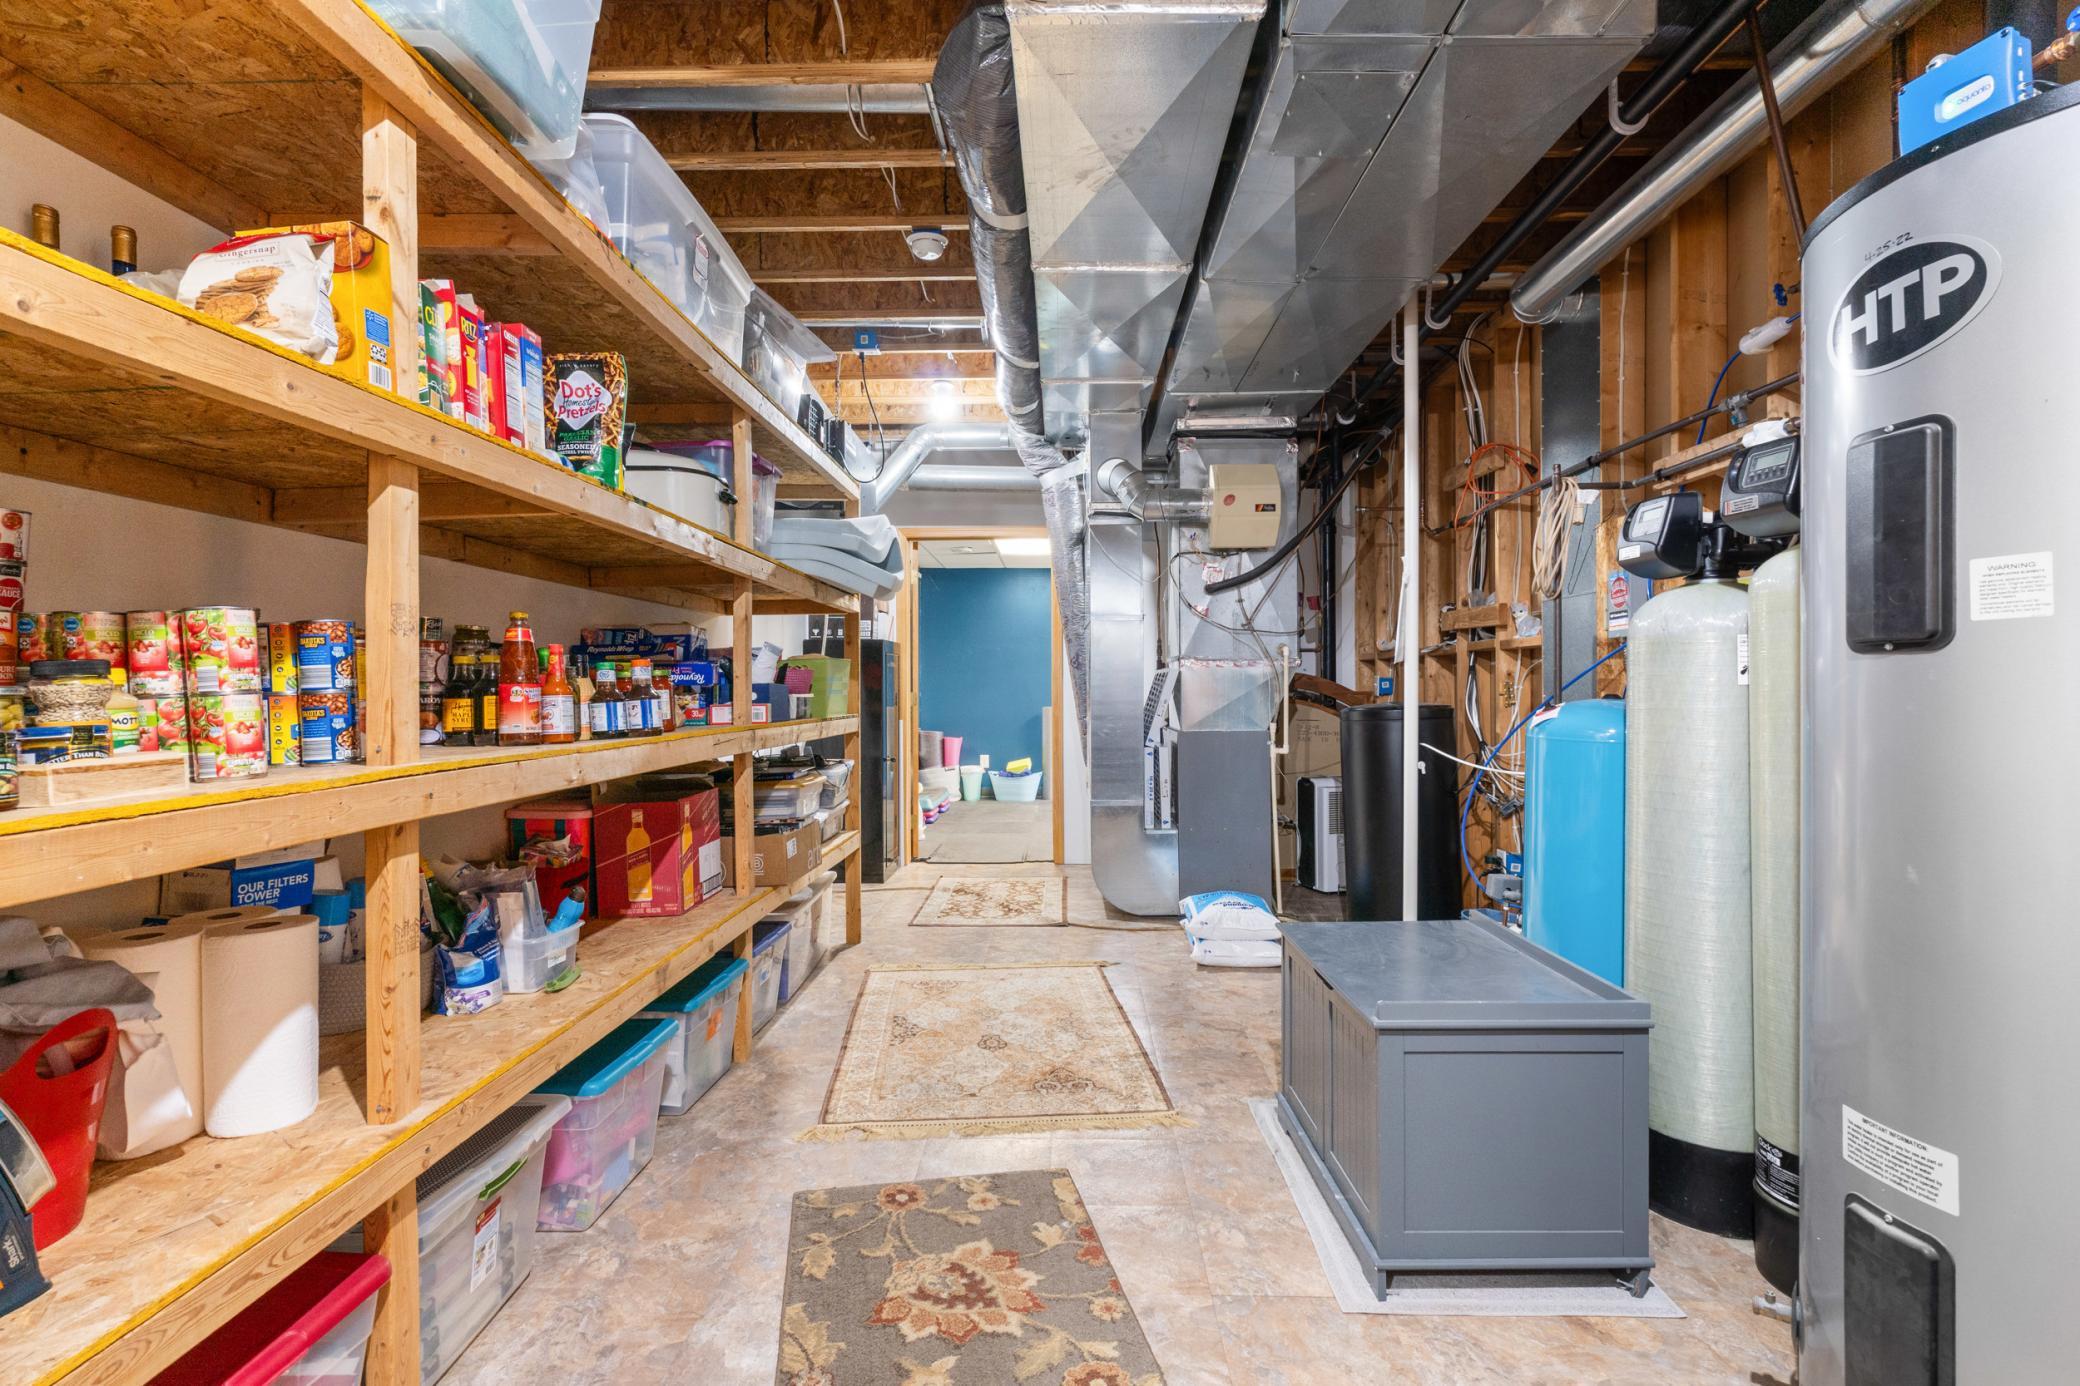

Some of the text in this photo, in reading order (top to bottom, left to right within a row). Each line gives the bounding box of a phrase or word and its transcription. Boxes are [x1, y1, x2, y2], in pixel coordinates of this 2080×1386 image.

[1840, 253, 1976, 356] HTP
[461, 315, 477, 338] RITZ
[560, 381, 602, 399] Dot's
[558, 400, 606, 420] Pretzels
[1986, 560, 2036, 573] WARNING
[238, 873, 309, 894] OUR FILTERS
[237, 888, 280, 904] TOWER
[1889, 1130, 1927, 1151] INFORMATION
